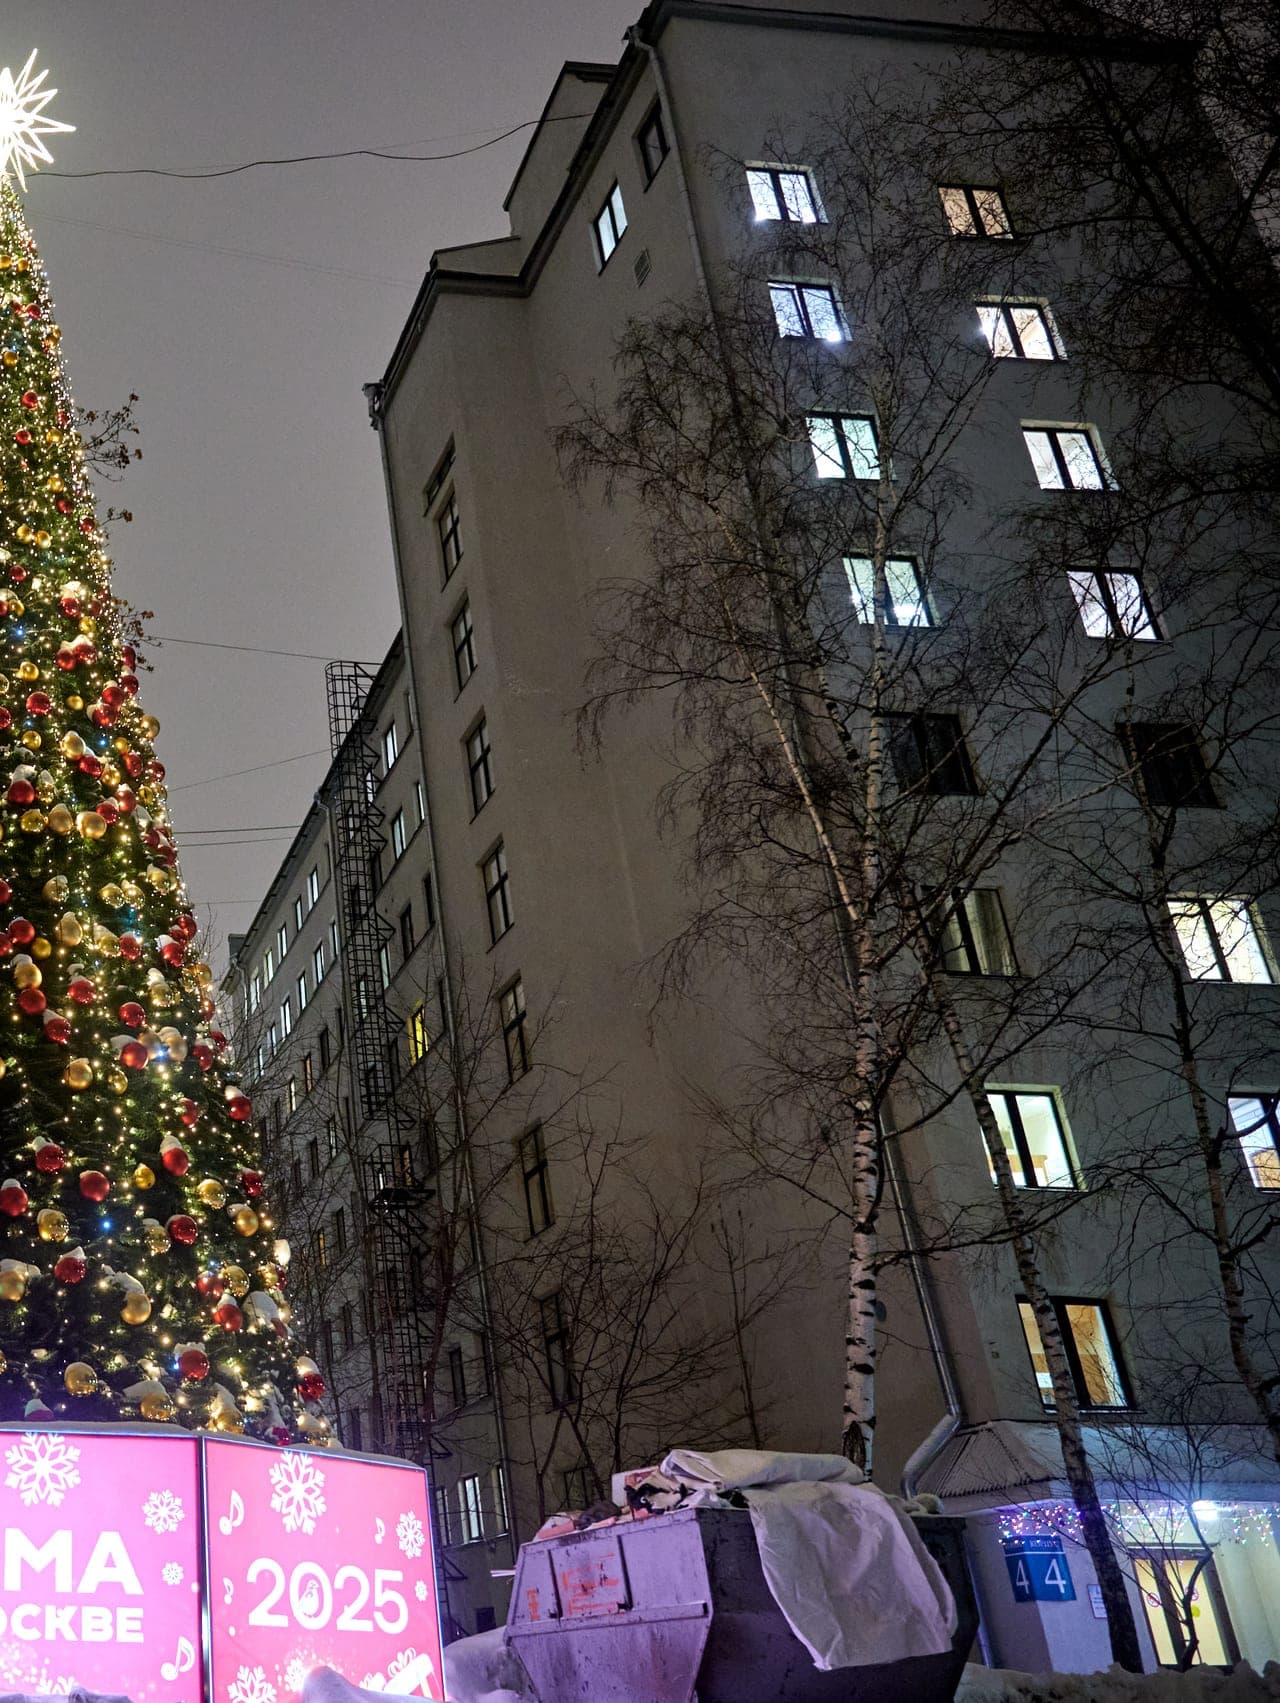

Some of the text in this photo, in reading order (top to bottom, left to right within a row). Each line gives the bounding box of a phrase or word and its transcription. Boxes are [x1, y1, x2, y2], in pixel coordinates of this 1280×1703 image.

[1015, 1559, 1030, 1595] 4
[1044, 1558, 1066, 1595] 4
[246, 1557, 409, 1635] 2025
